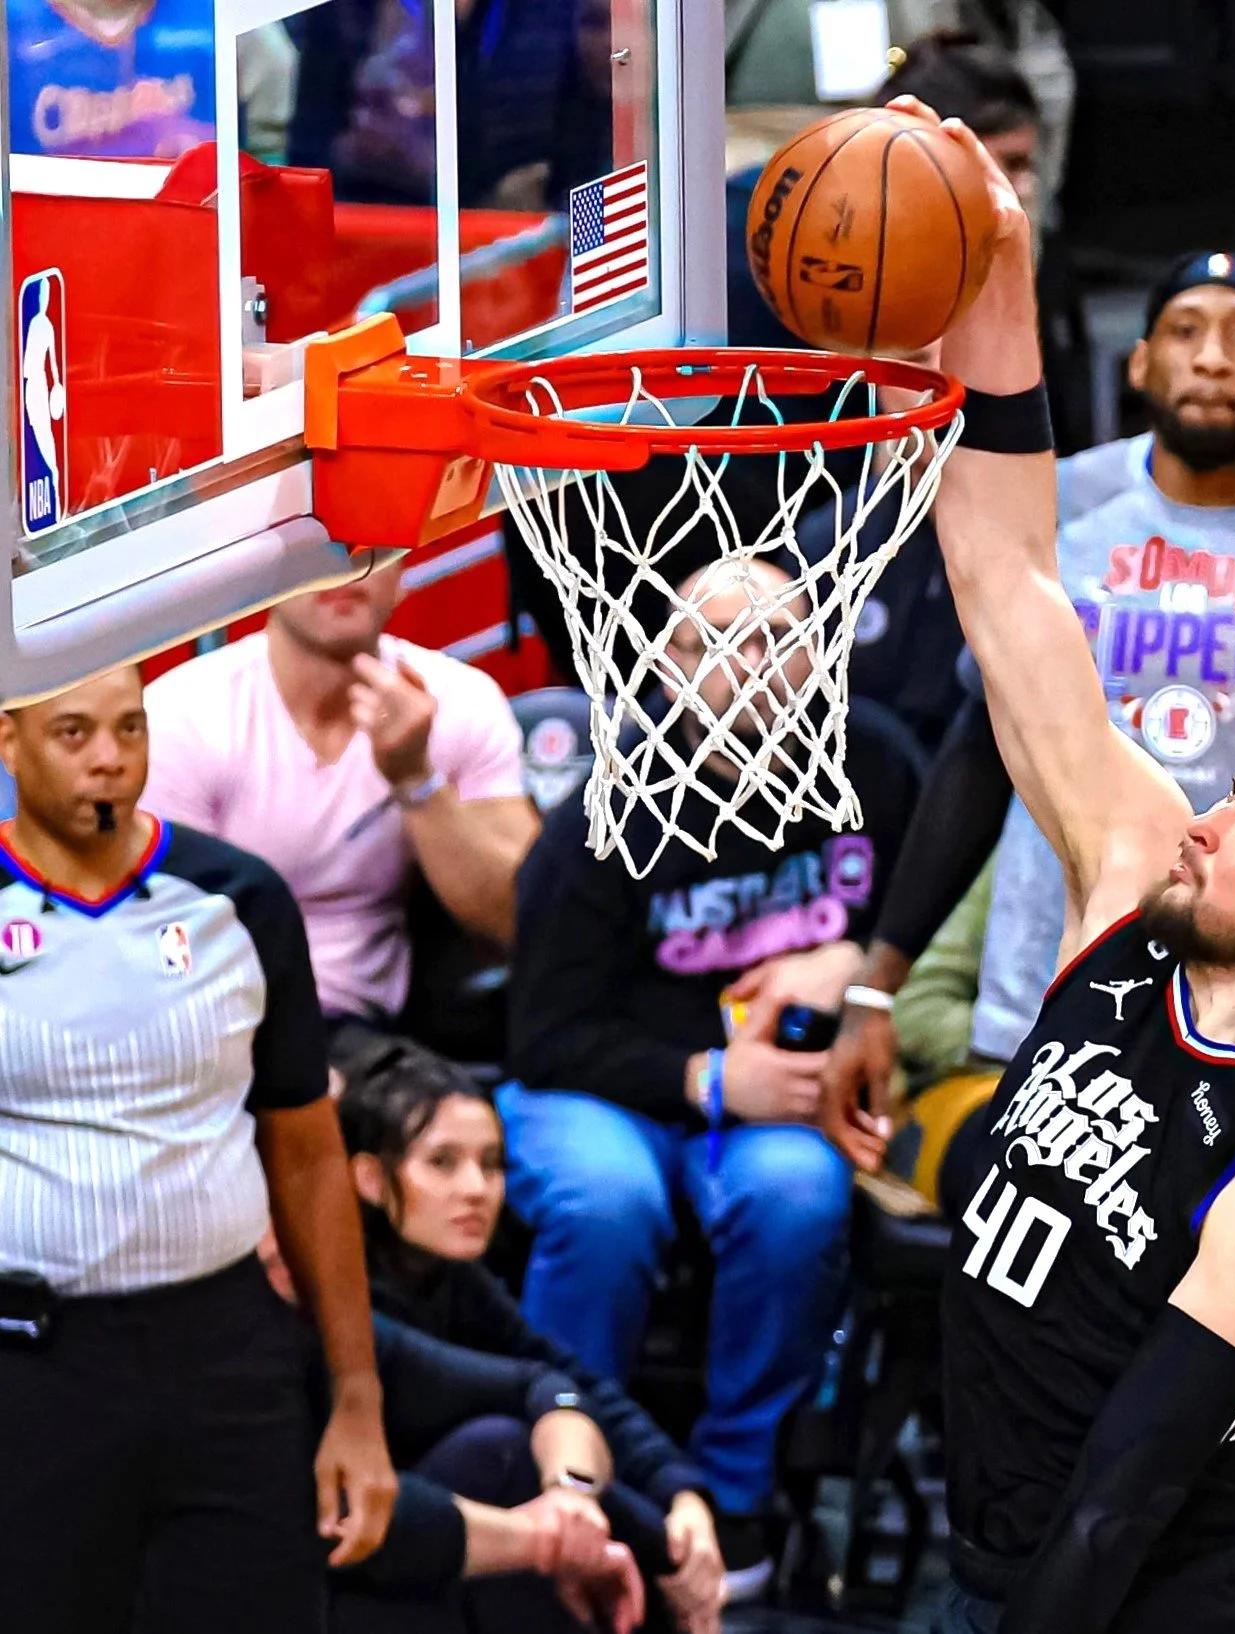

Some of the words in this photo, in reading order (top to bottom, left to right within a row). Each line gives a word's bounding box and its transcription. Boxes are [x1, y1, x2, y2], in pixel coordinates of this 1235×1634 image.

[29, 475, 51, 521] NBA
[1032, 1040, 1160, 1148] Los
[1191, 1081, 1224, 1147] honey
[991, 1079, 1159, 1271] Angeles
[962, 1164, 1072, 1308] 40
